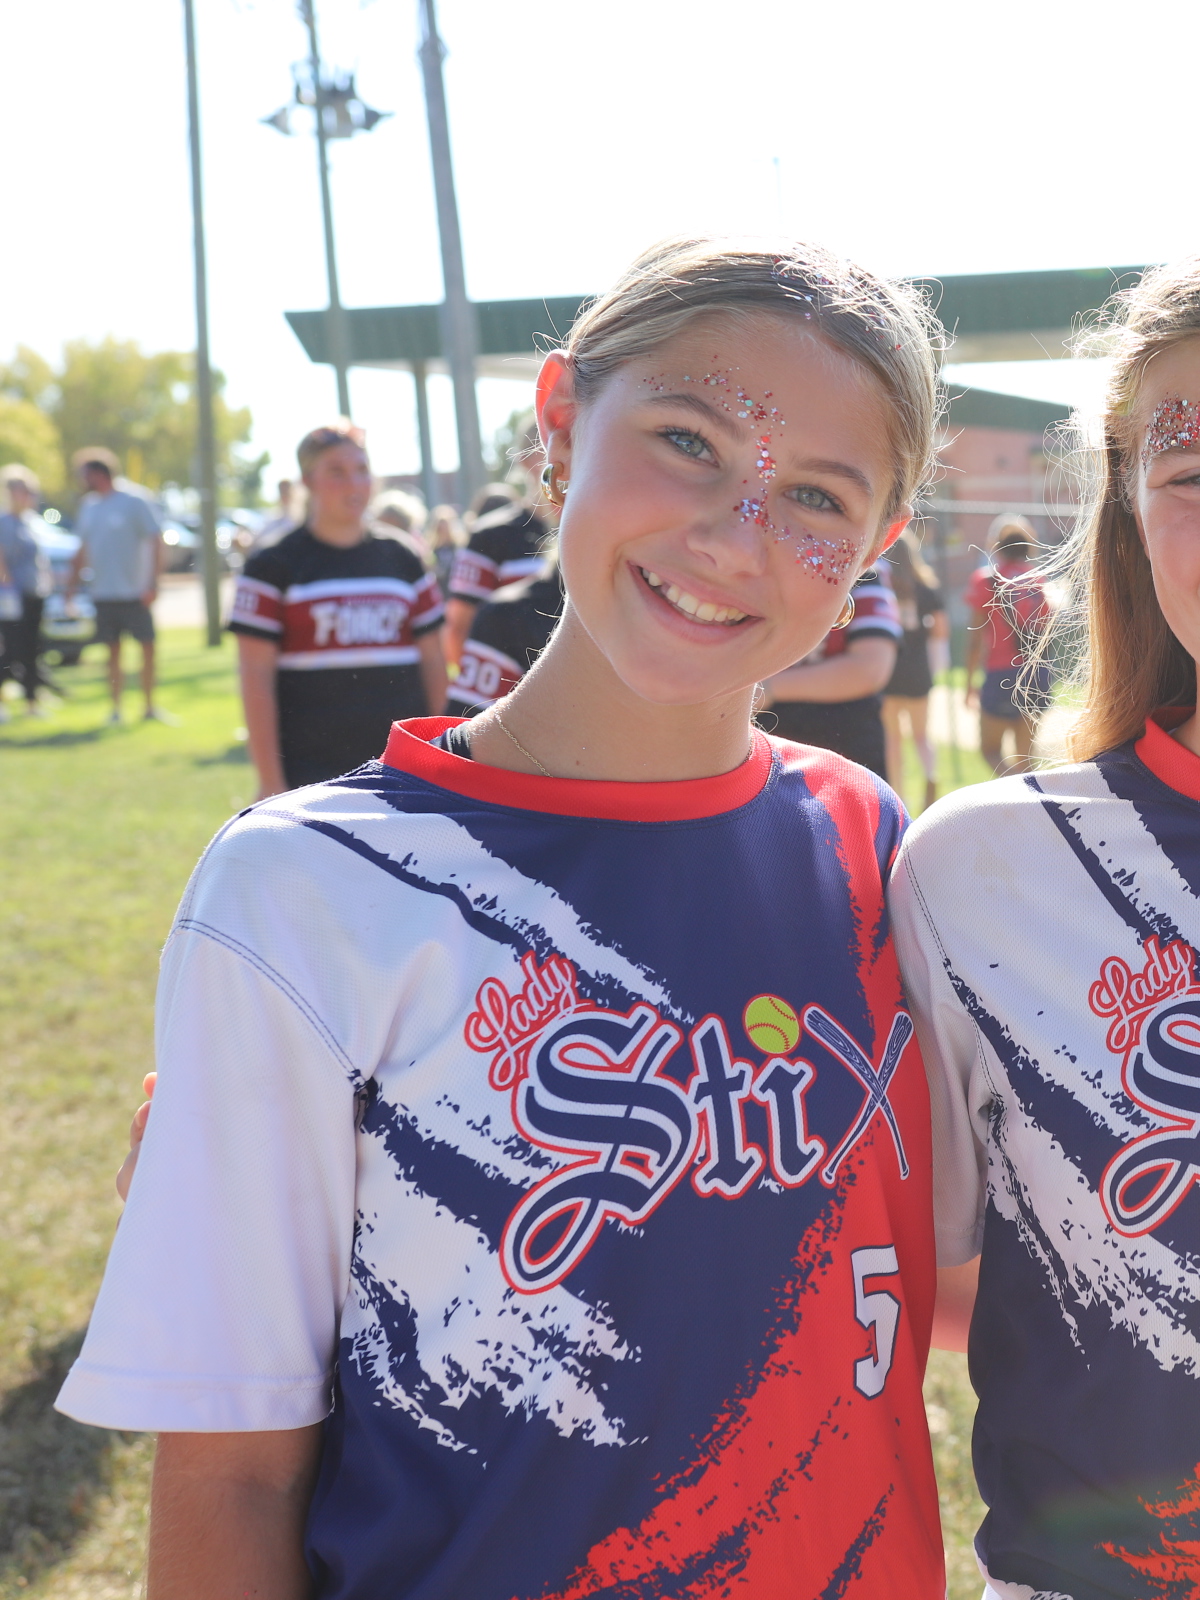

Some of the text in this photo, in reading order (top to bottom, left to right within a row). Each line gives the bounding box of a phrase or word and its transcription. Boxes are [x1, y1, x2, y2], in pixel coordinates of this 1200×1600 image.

[457, 653, 502, 696] 30
[465, 950, 592, 1090] Lady
[850, 1243, 901, 1400] 5
